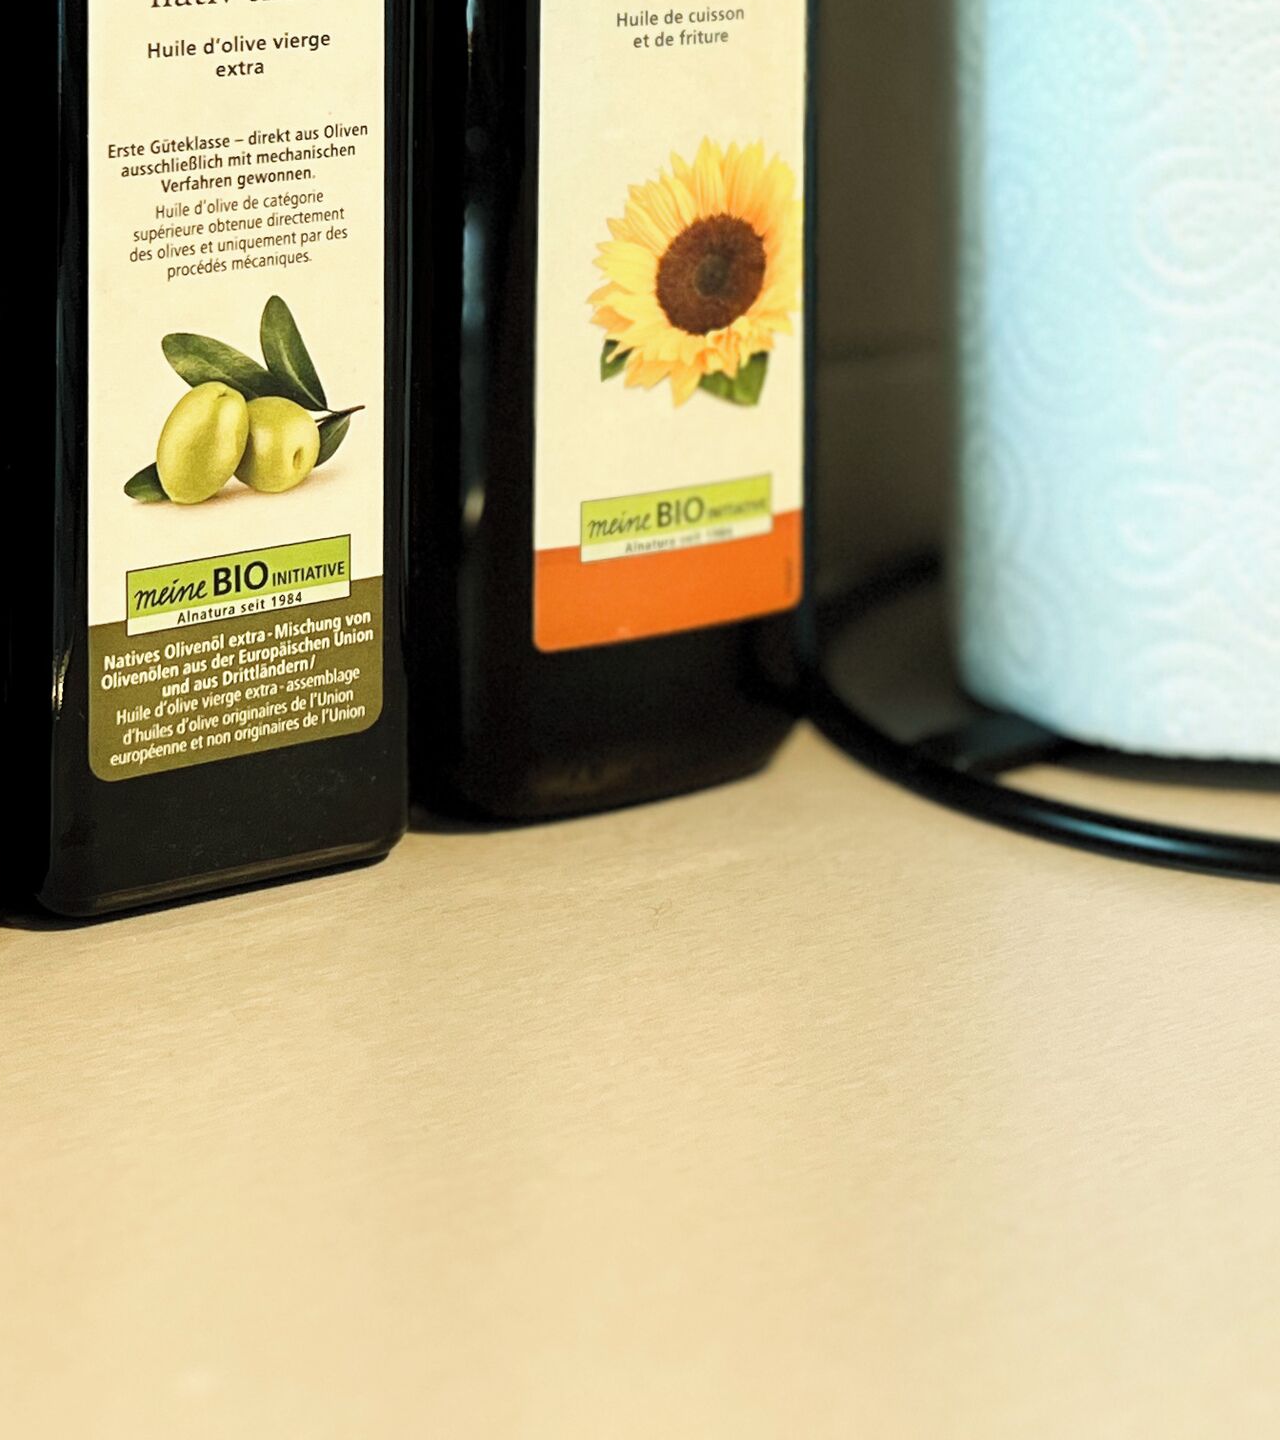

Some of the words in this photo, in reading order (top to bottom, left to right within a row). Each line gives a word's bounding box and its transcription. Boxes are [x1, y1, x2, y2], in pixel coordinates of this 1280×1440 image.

[617, 12, 659, 28] Huile
[664, 10, 684, 25] de
[689, 7, 744, 24] cuisson
[148, 39, 197, 59] Huile
[273, 33, 330, 51] vierge
[633, 34, 650, 48] et
[655, 32, 674, 47] de
[680, 30, 728, 46] friture
[216, 61, 264, 77] extra
[108, 143, 144, 159] Erste
[150, 136, 230, 155] Güteklasse
[248, 129, 291, 146] direkt
[295, 128, 319, 141] aus
[324, 123, 368, 138] Oliven
[121, 154, 223, 177] ausschließlich
[228, 153, 251, 167] mit
[256, 144, 355, 165] mechanischen
[161, 175, 232, 193] Verfahren
[237, 168, 316, 189] gewonnen.
[155, 203, 190, 220] Huile
[243, 196, 259, 210] de
[263, 189, 323, 209] catégorie
[133, 222, 204, 244] supérieure
[208, 217, 263, 234] obtenue
[267, 208, 345, 228] directement
[129, 248, 152, 262] des
[157, 243, 195, 259] olives
[200, 241, 213, 254] et
[217, 231, 296, 255] uniquement
[300, 231, 321, 248] par
[326, 227, 348, 240] des
[167, 261, 227, 281] procédés
[231, 250, 312, 275] mécaniques.
[587, 511, 652, 539] meine
[657, 497, 705, 528] BIO
[134, 579, 208, 610] meine
[213, 561, 269, 596] BIO
[272, 562, 344, 586] INITIATIVE
[177, 605, 235, 624] Alnatura
[241, 599, 266, 612] seit
[271, 592, 302, 607] 1984
[104, 650, 160, 671] Natives
[165, 634, 224, 658] Olivenöl
[346, 612, 371, 626] von
[101, 664, 179, 690] Olivenölen
[183, 662, 207, 674] aus
[211, 654, 234, 669] der
[239, 639, 330, 664] Europäischen
[334, 629, 373, 647] Union
[162, 682, 190, 697] und
[194, 677, 218, 691] aus
[222, 655, 316, 686] Drittländern/
[116, 708, 151, 725] Huile
[202, 689, 241, 709] vierge
[222, 704, 287, 727] originaires
[291, 698, 306, 710] de
[110, 741, 187, 767] européenne
[190, 739, 203, 750] et
[207, 734, 231, 746] non
[234, 719, 300, 742] originaires
[303, 714, 318, 727] de
